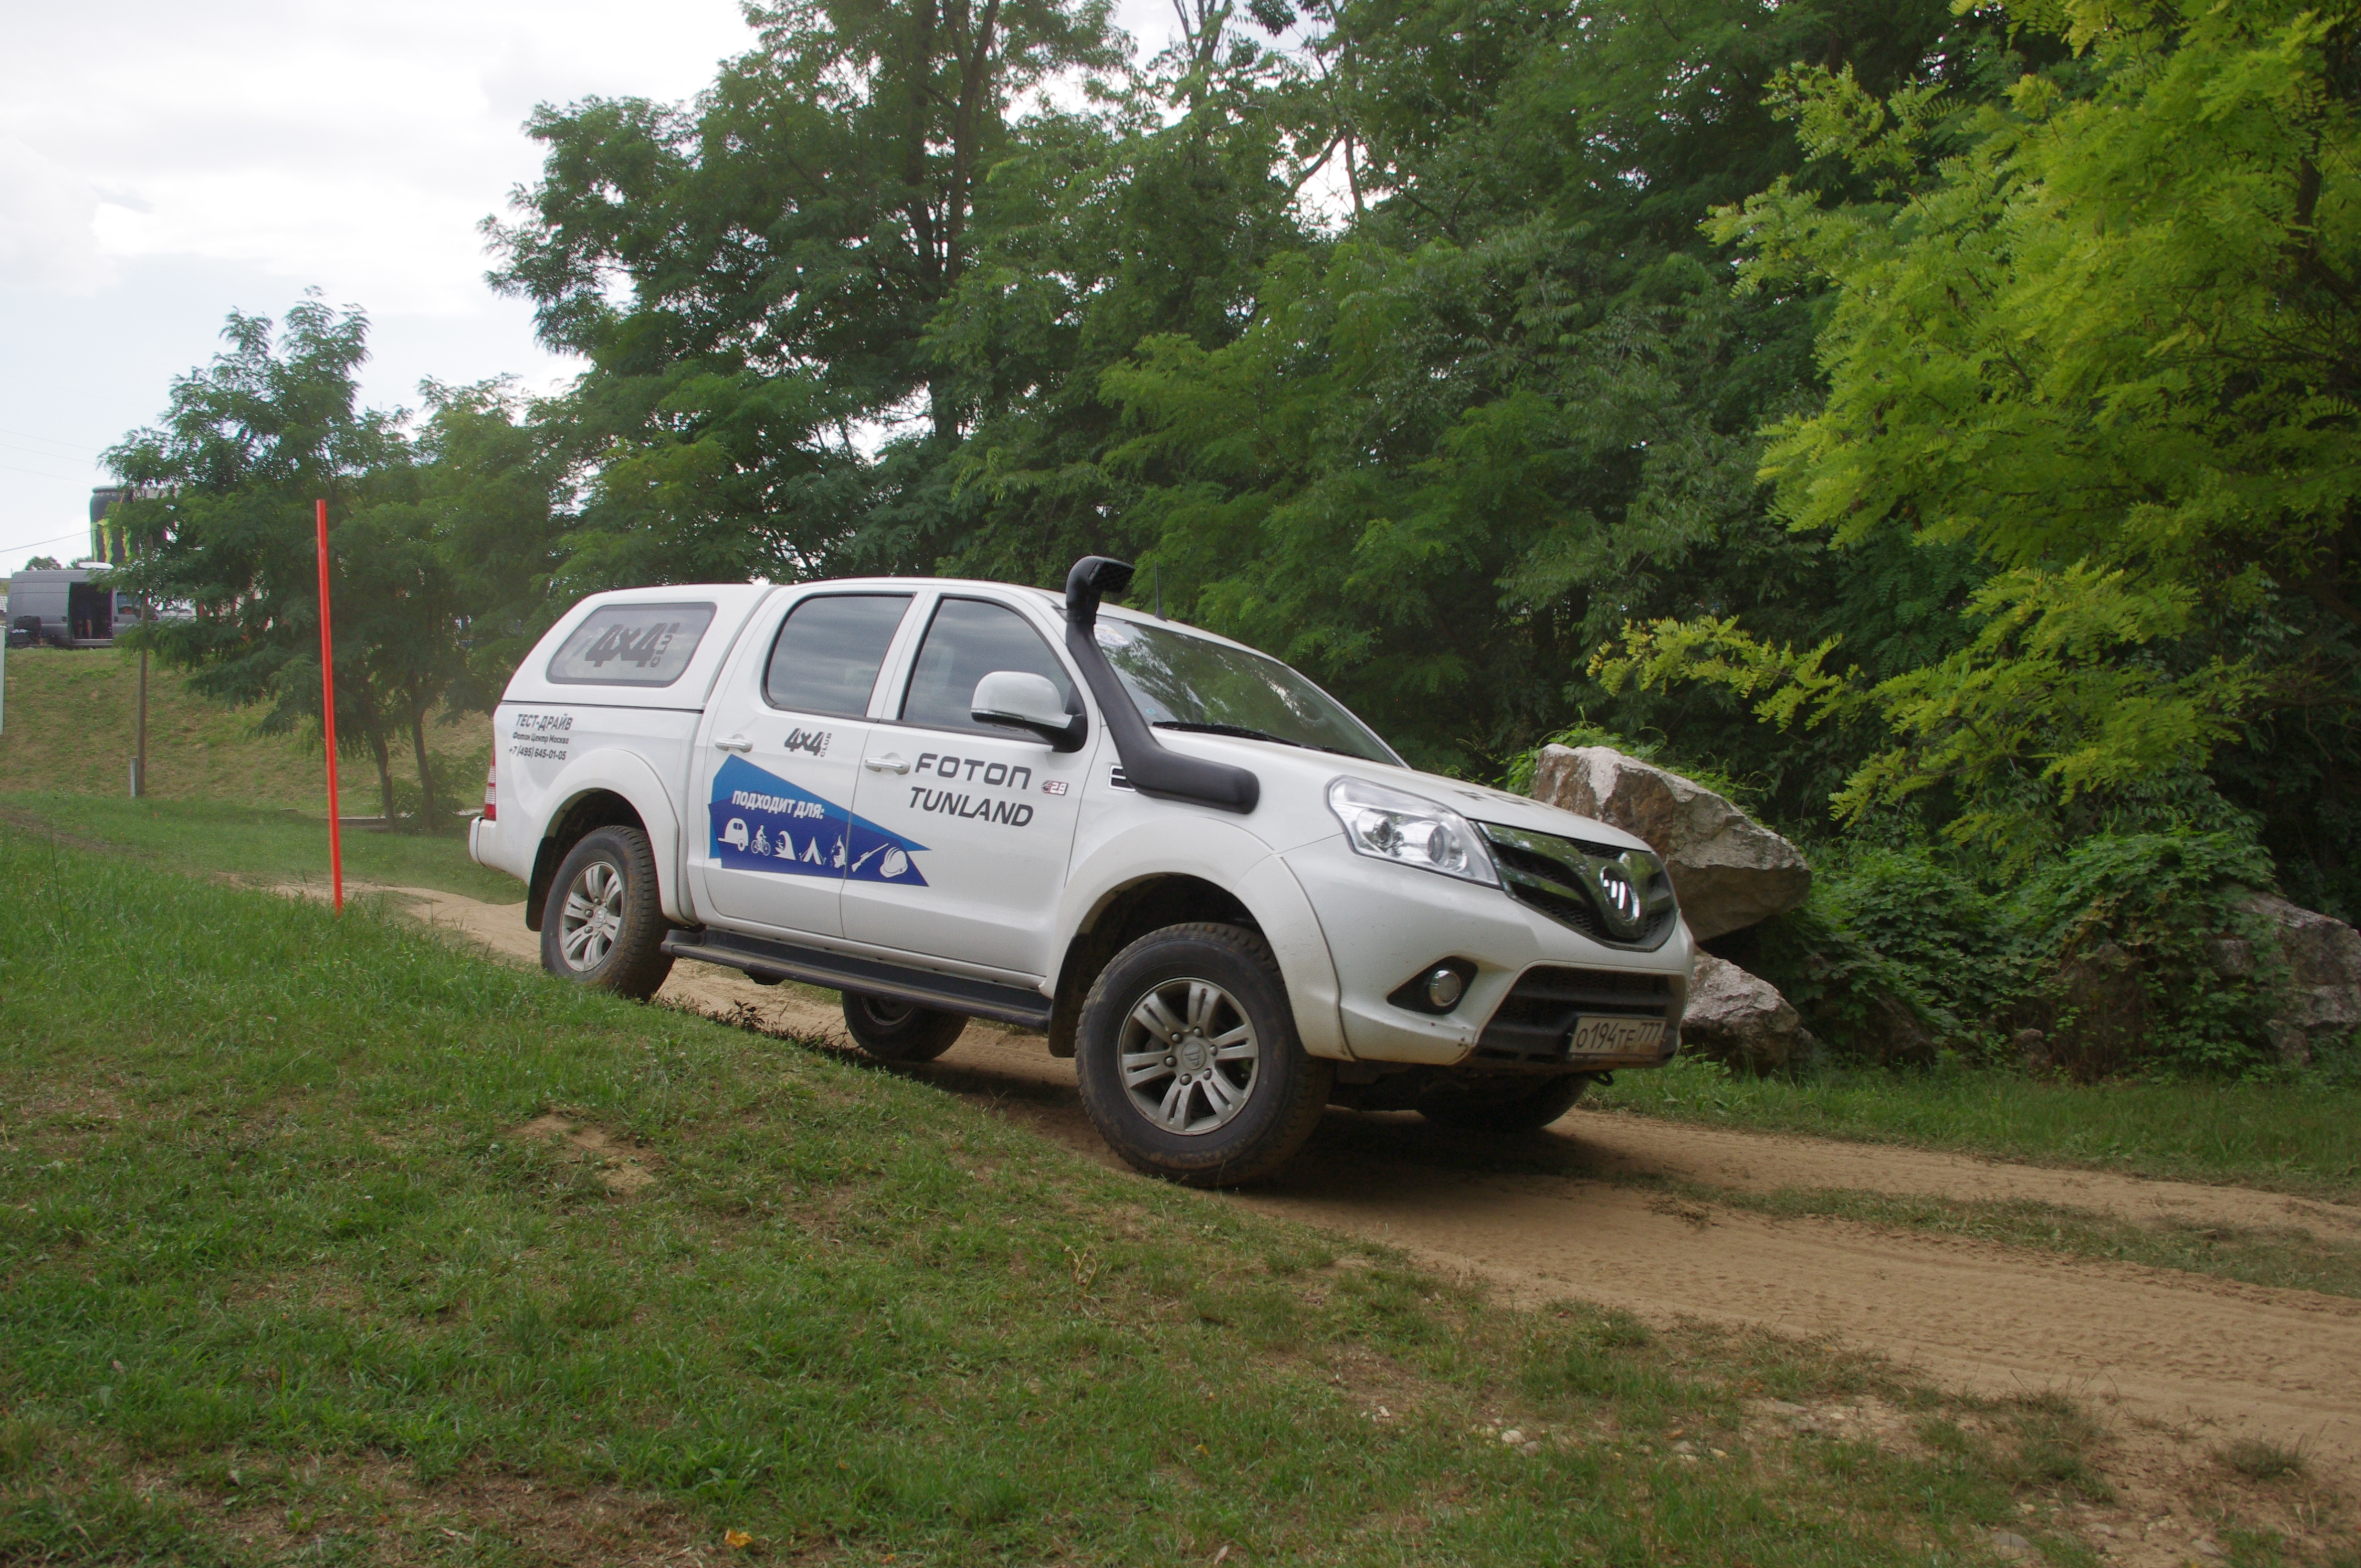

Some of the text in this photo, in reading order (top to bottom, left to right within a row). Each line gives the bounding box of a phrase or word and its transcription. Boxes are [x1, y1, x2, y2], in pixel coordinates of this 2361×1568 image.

[516, 714, 573, 731] ТЕСТ-ДРАЙВ
[513, 732, 569, 744] Фотон Центр Москва
[820, 733, 832, 757] CLUB
[516, 745, 535, 758] (495)
[534, 748, 567, 760] 645-01-05
[732, 790, 825, 819] ПОДХОДИТ ДЛЯ:
[910, 786, 1033, 827] TUNLAND
